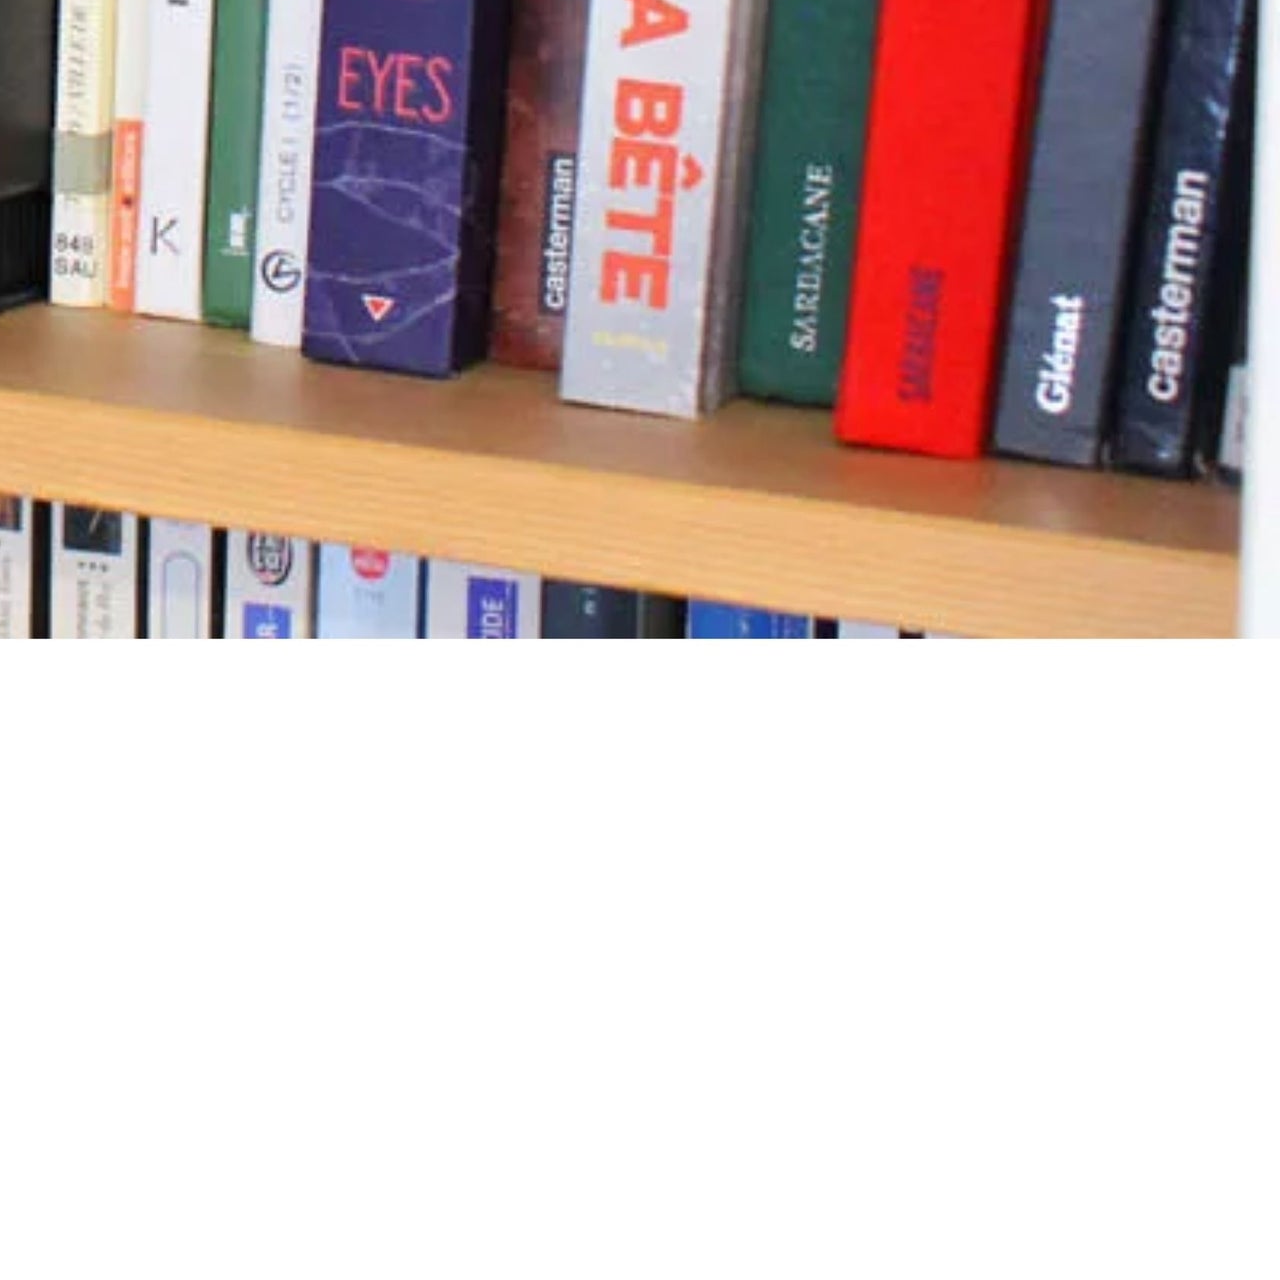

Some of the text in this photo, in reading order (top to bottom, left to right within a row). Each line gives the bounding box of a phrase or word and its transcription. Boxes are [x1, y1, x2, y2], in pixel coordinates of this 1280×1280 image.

[336, 45, 454, 125] EYES
[149, 216, 181, 257] K
[274, 151, 297, 224] CYCLE
[542, 158, 574, 310] casterman
[600, 76, 704, 312] BÊTE
[1142, 168, 1211, 404] casterman
[1035, 295, 1085, 416] Glénat
